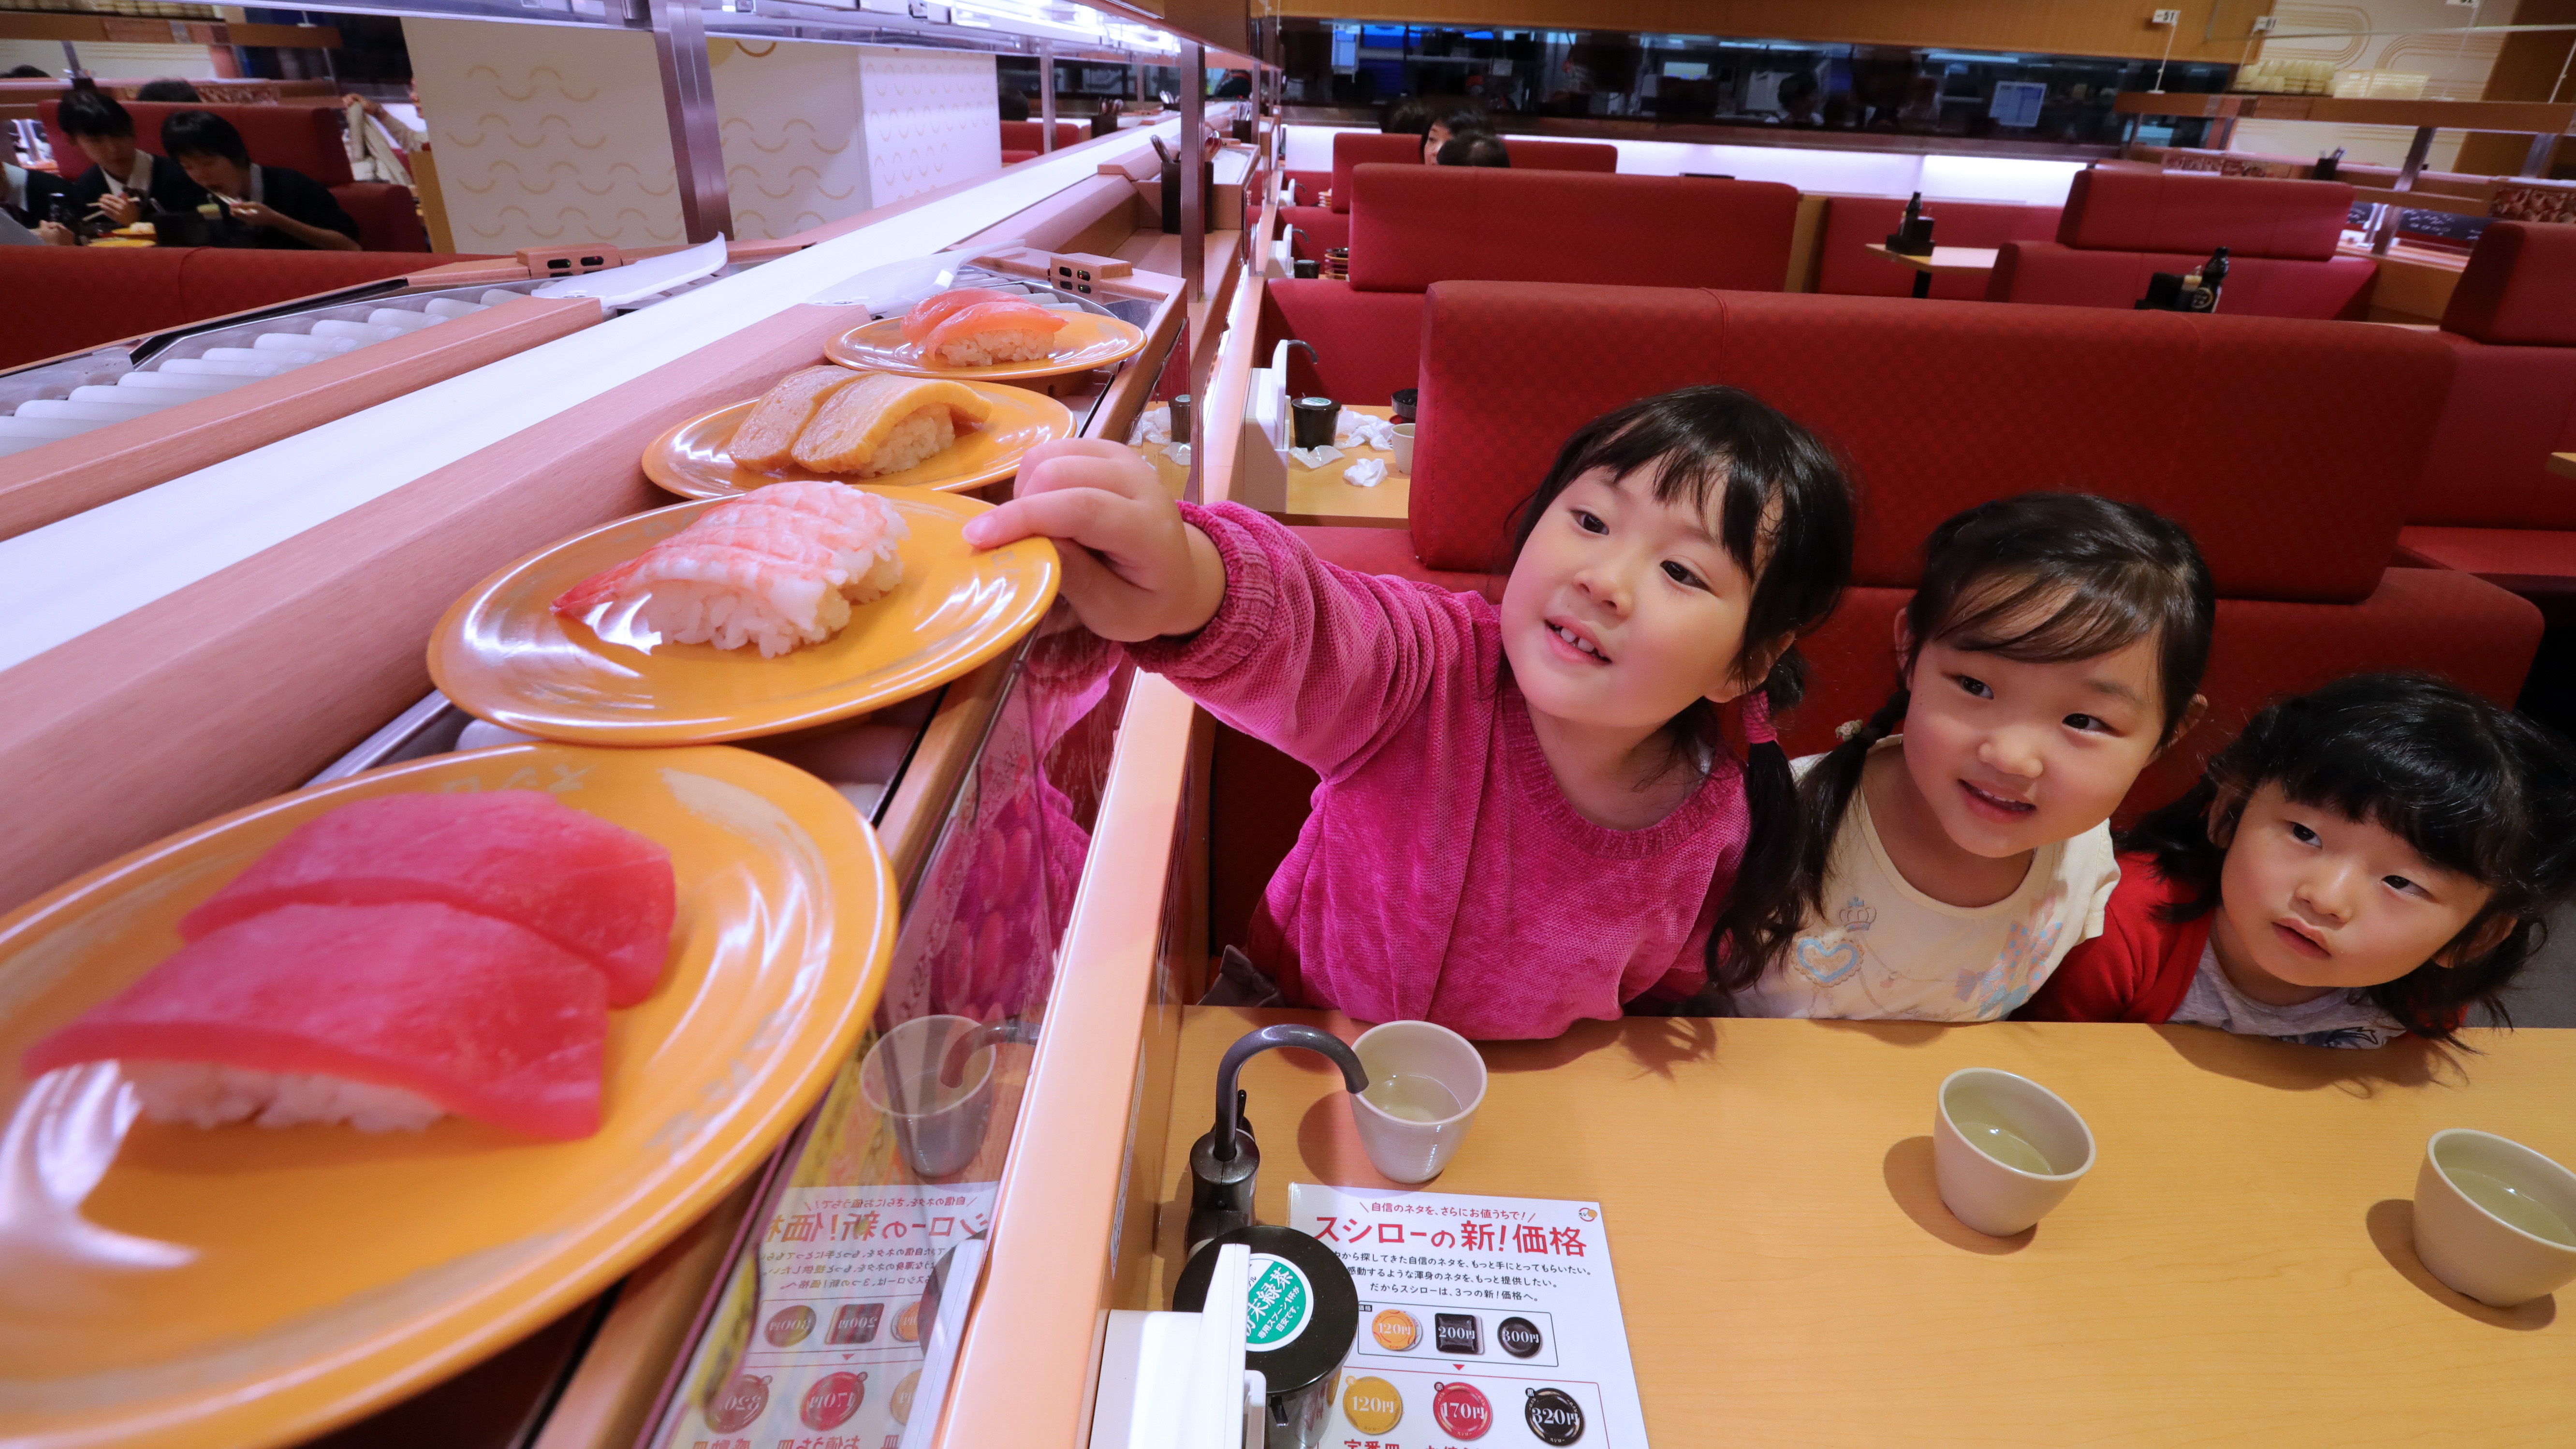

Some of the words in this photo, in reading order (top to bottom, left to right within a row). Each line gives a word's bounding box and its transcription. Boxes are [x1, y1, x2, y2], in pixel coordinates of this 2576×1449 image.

[1314, 1216, 1587, 1257] スシローの新!価格
[1378, 1322, 1412, 1335] 120円
[1438, 1326, 1475, 1340] 200円
[1503, 1330, 1539, 1344] 300円
[1350, 1395, 1394, 1414] 120円
[1441, 1402, 1485, 1420] 170円
[1531, 1407, 1580, 1426] 320円
